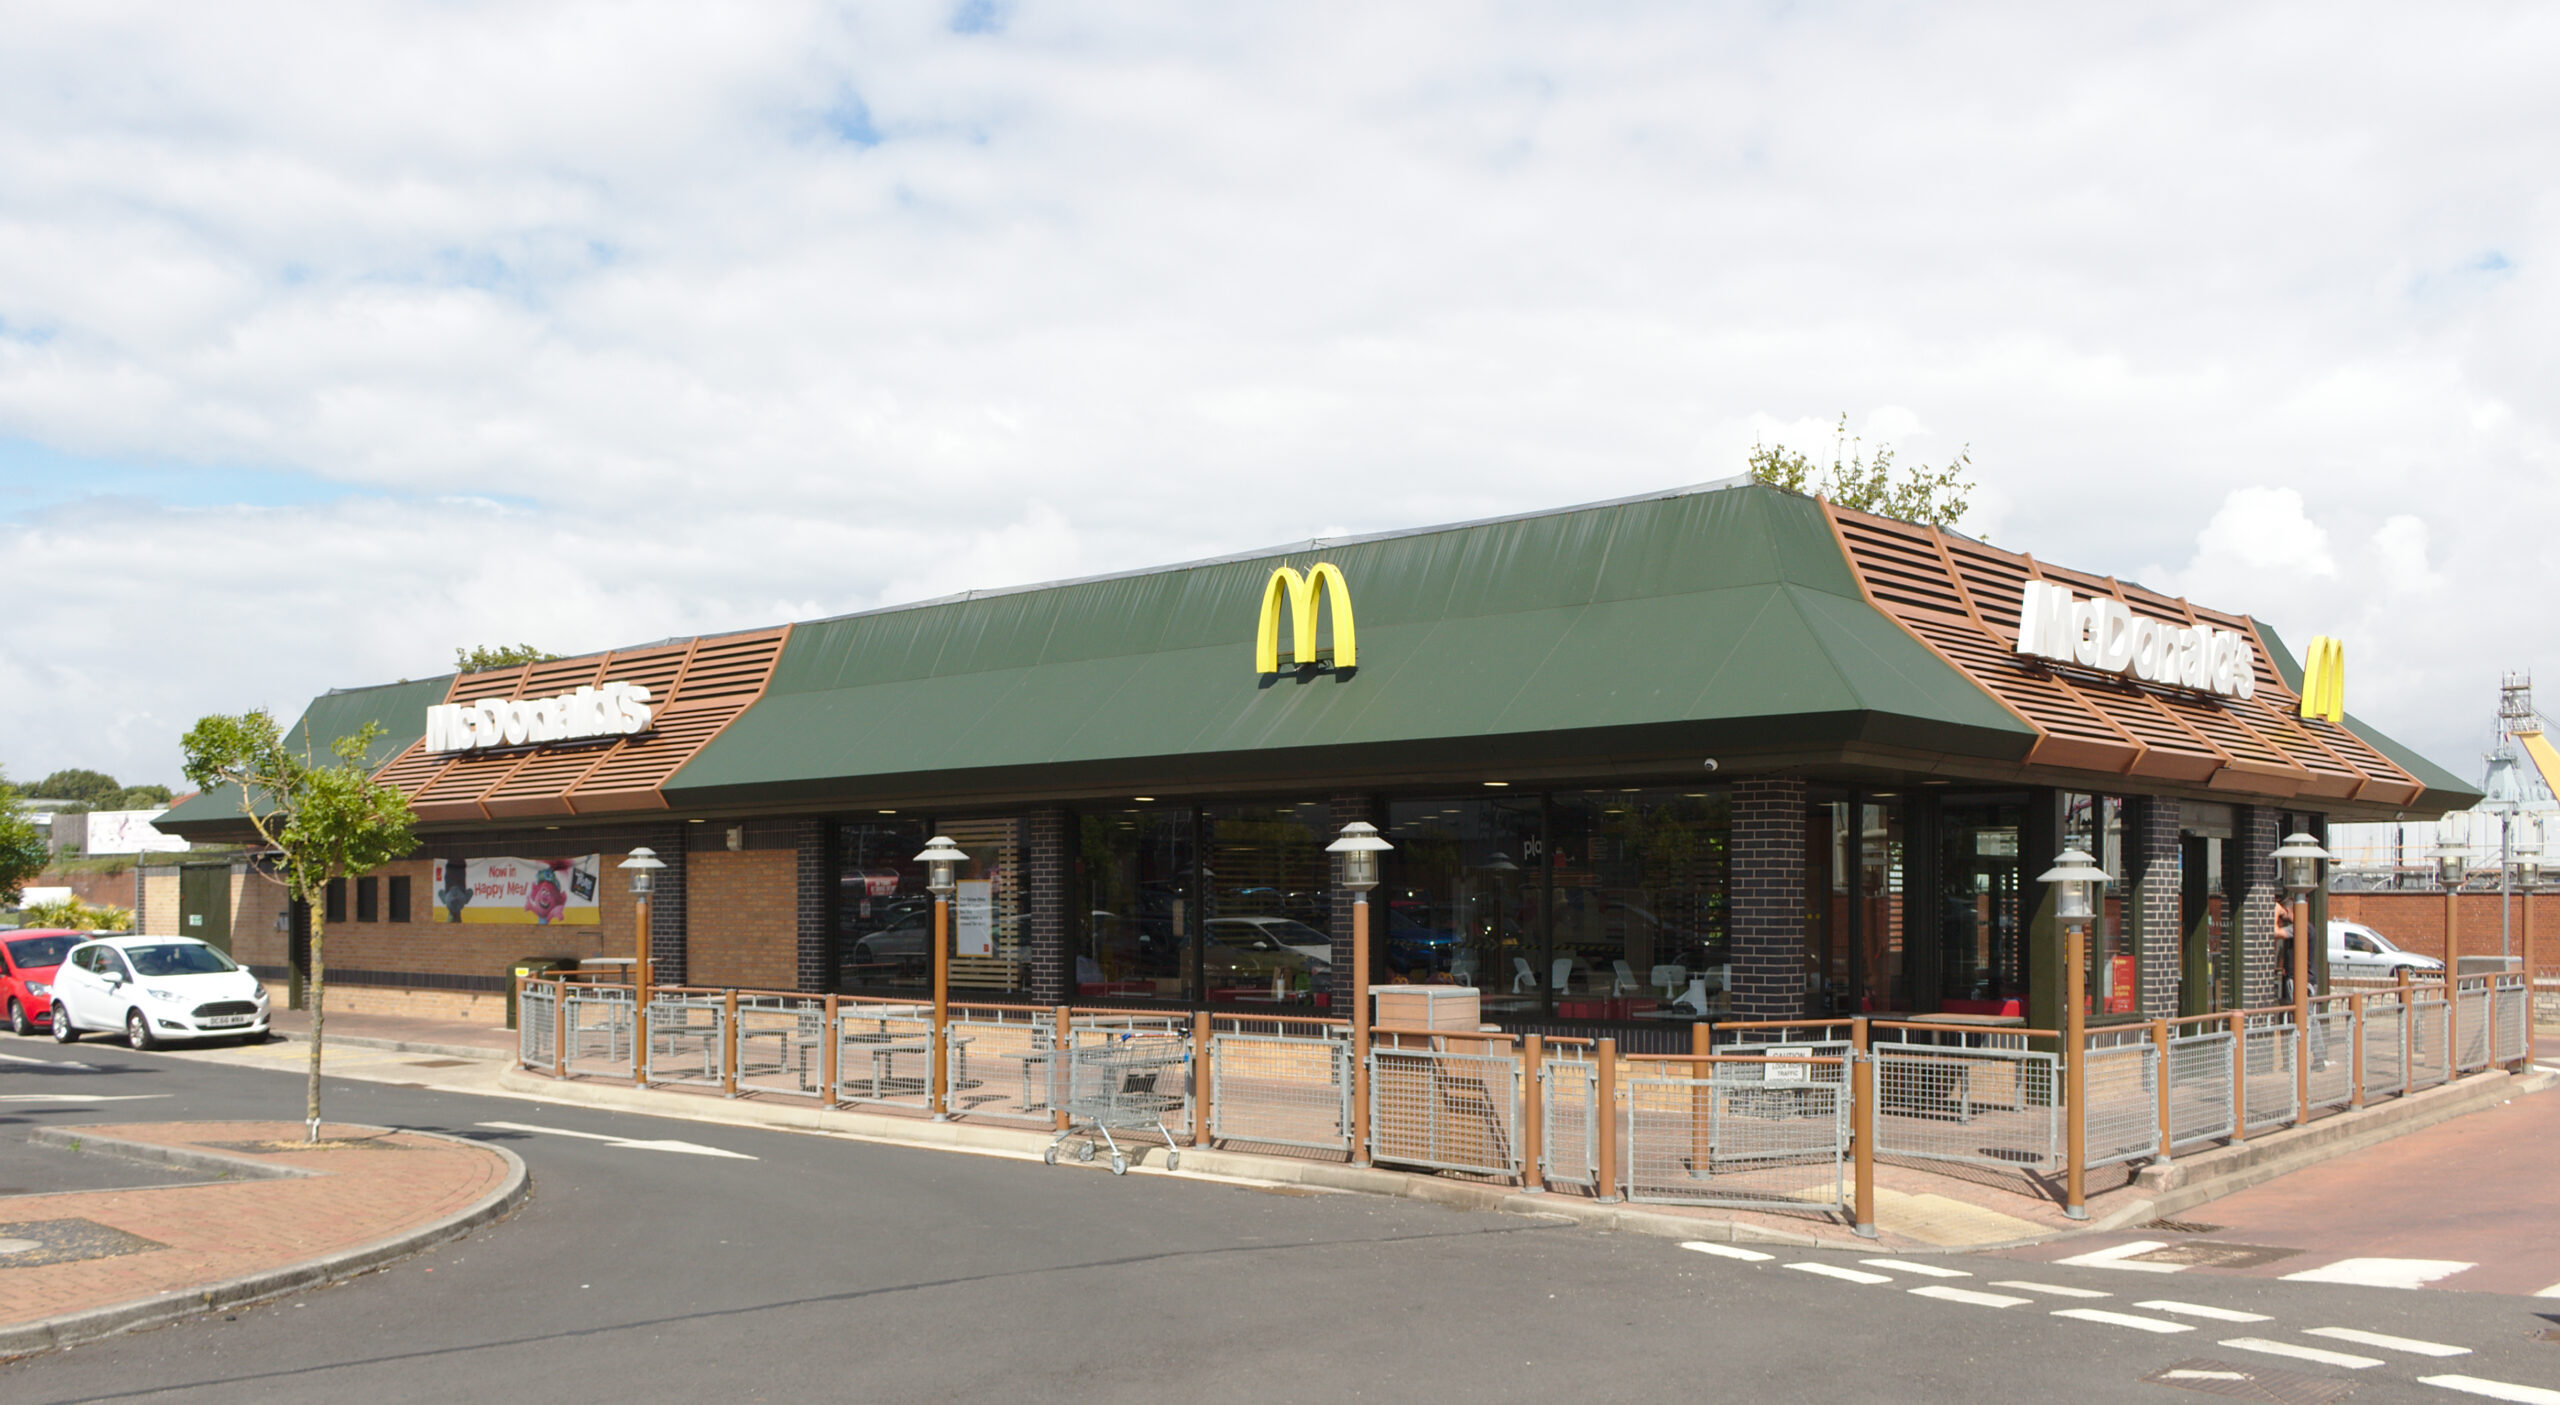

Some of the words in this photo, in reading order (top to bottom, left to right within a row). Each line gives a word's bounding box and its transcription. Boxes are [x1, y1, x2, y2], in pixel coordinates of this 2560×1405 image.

[2016, 580, 2255, 700] McDonald's
[425, 681, 652, 753] McDonald's
[474, 881, 504, 900] Happy
[489, 864, 507, 878] Now
[509, 864, 517, 878] in
